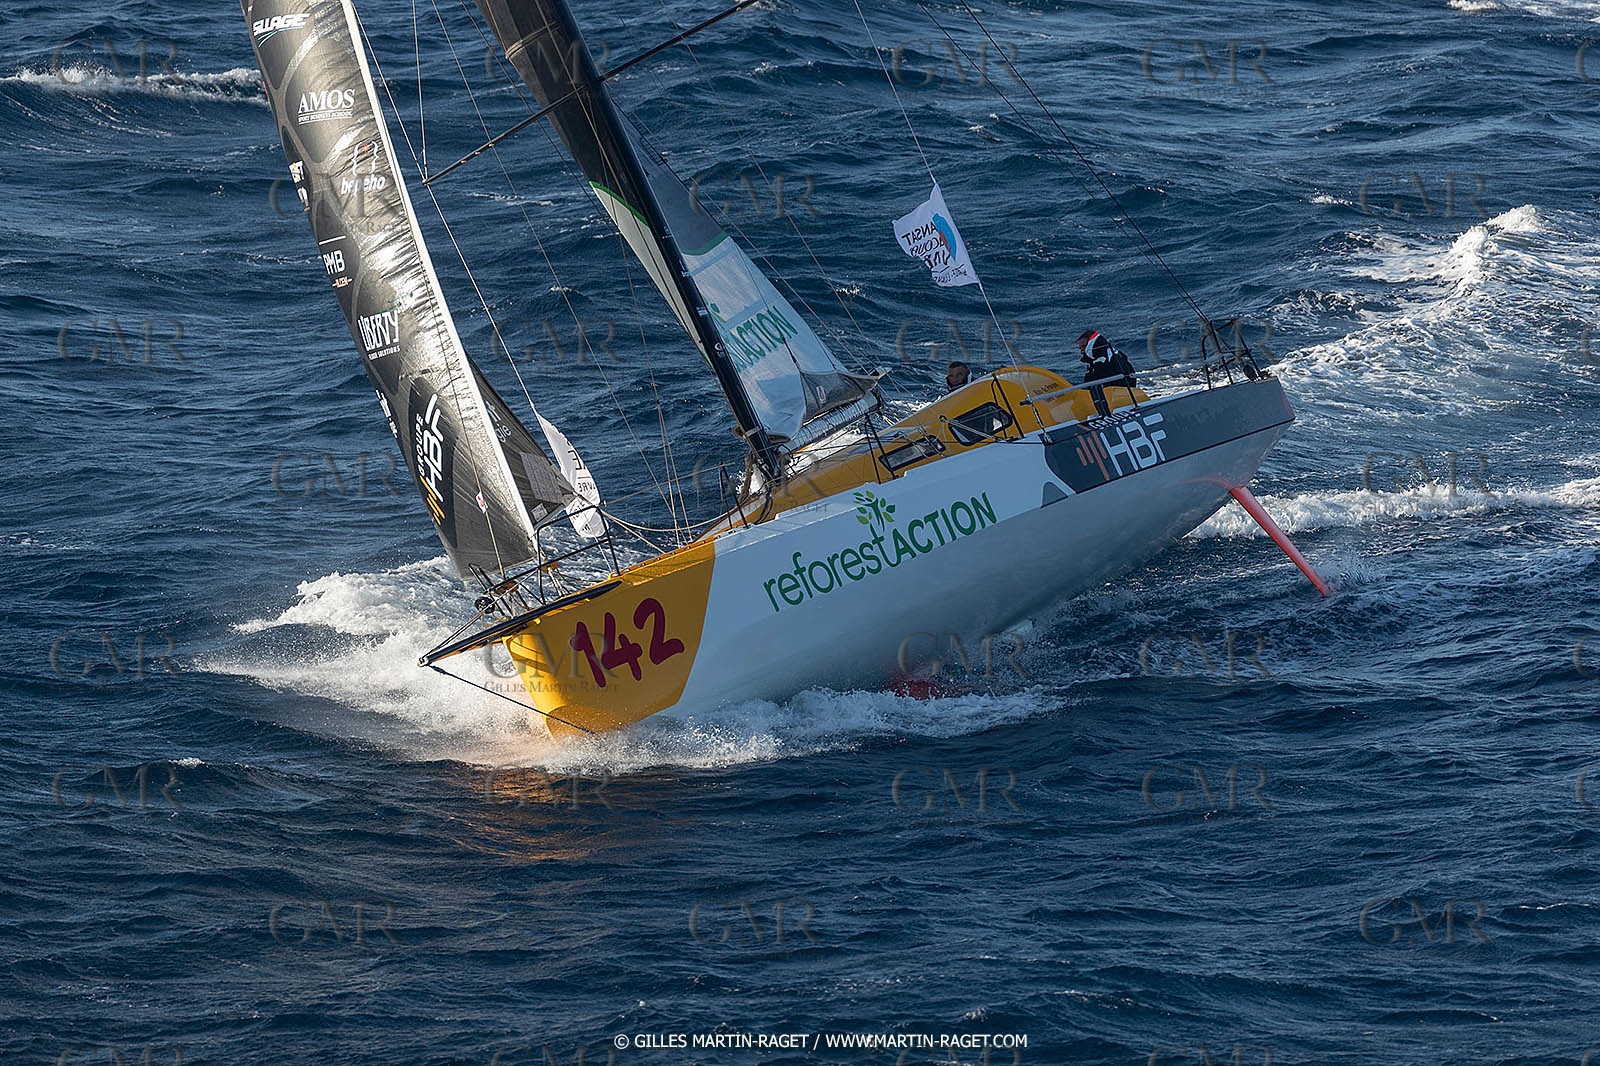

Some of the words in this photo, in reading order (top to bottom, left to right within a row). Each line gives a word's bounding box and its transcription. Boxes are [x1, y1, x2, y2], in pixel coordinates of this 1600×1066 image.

[297, 88, 355, 114] AMOS
[322, 249, 346, 275] PMB
[358, 308, 400, 352] LIBERTY
[415, 412, 425, 477] GROUPE
[423, 393, 445, 503] HBF
[1099, 412, 1167, 477] HBF
[763, 491, 998, 613] reforestACTION
[569, 597, 685, 688] 142
